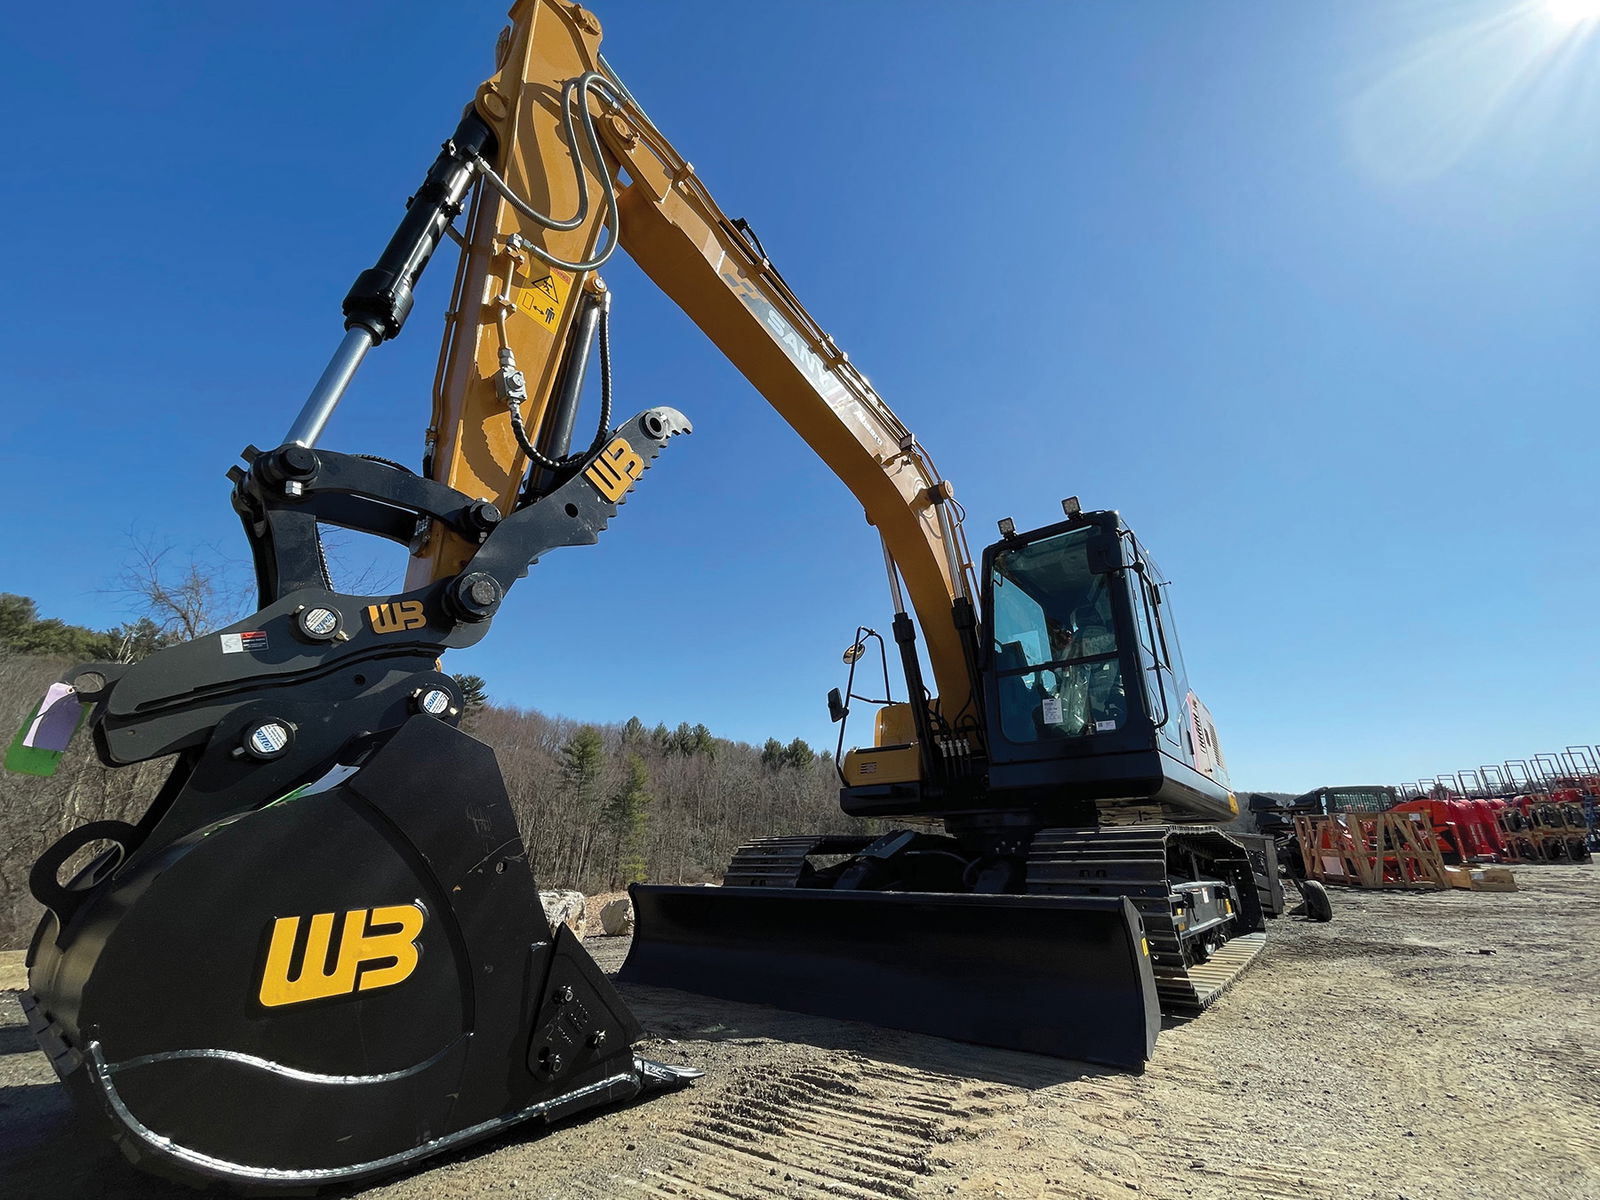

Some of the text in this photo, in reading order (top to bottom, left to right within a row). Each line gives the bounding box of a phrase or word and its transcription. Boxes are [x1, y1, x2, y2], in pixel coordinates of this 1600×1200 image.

[767, 309, 833, 387] SANY
[584, 437, 645, 502] WB
[367, 600, 427, 634] WB
[259, 904, 424, 1007] WB
